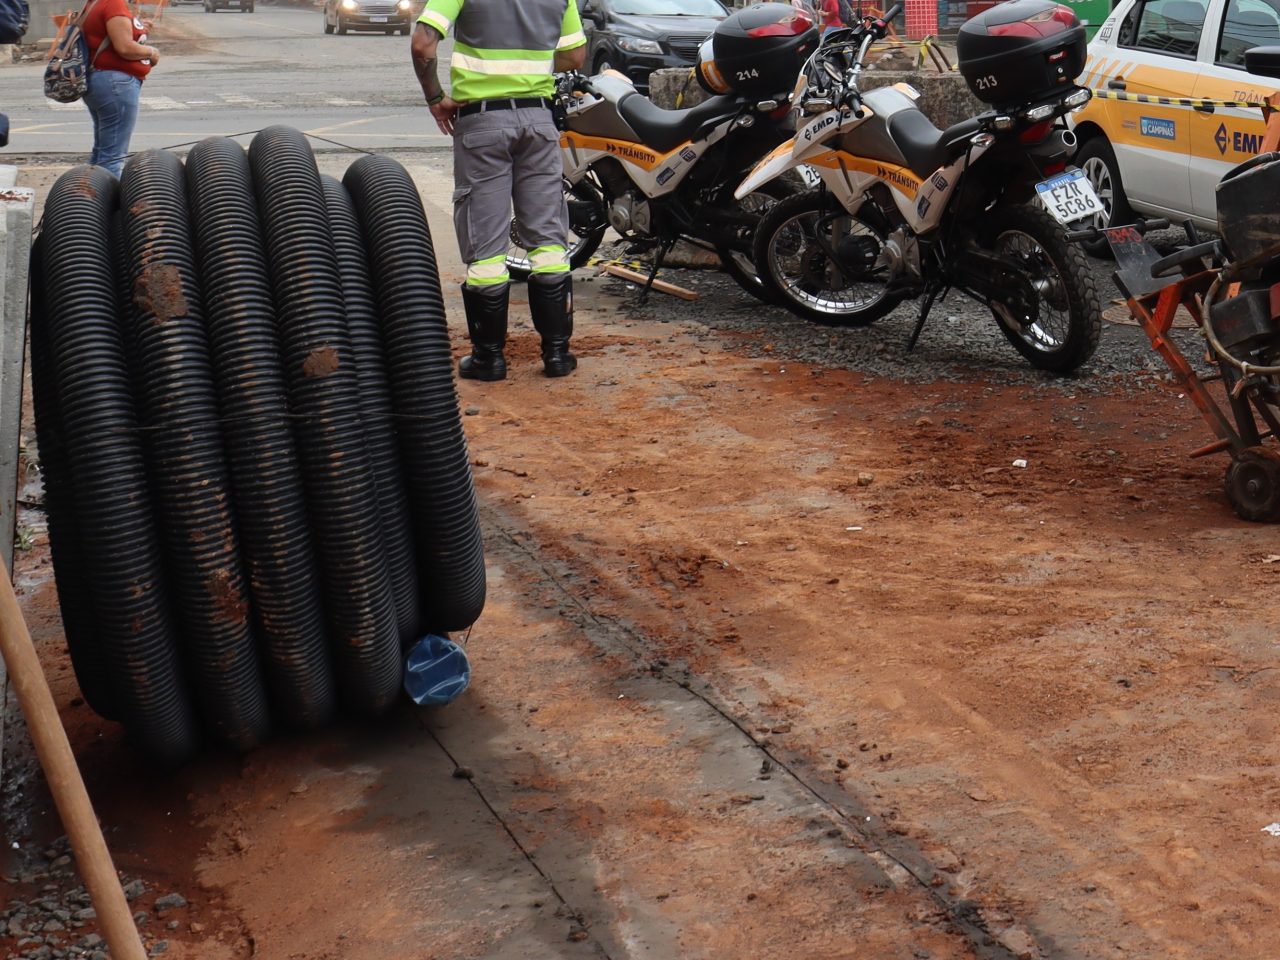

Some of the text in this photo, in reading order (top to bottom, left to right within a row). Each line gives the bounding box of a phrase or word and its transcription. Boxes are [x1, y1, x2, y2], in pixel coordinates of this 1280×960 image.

[736, 68, 759, 81] 214
[976, 74, 998, 90] 213
[1148, 125, 1175, 137] CAMPINAS
[1051, 182, 1083, 203] FZR
[1055, 194, 1096, 218] 5C86
